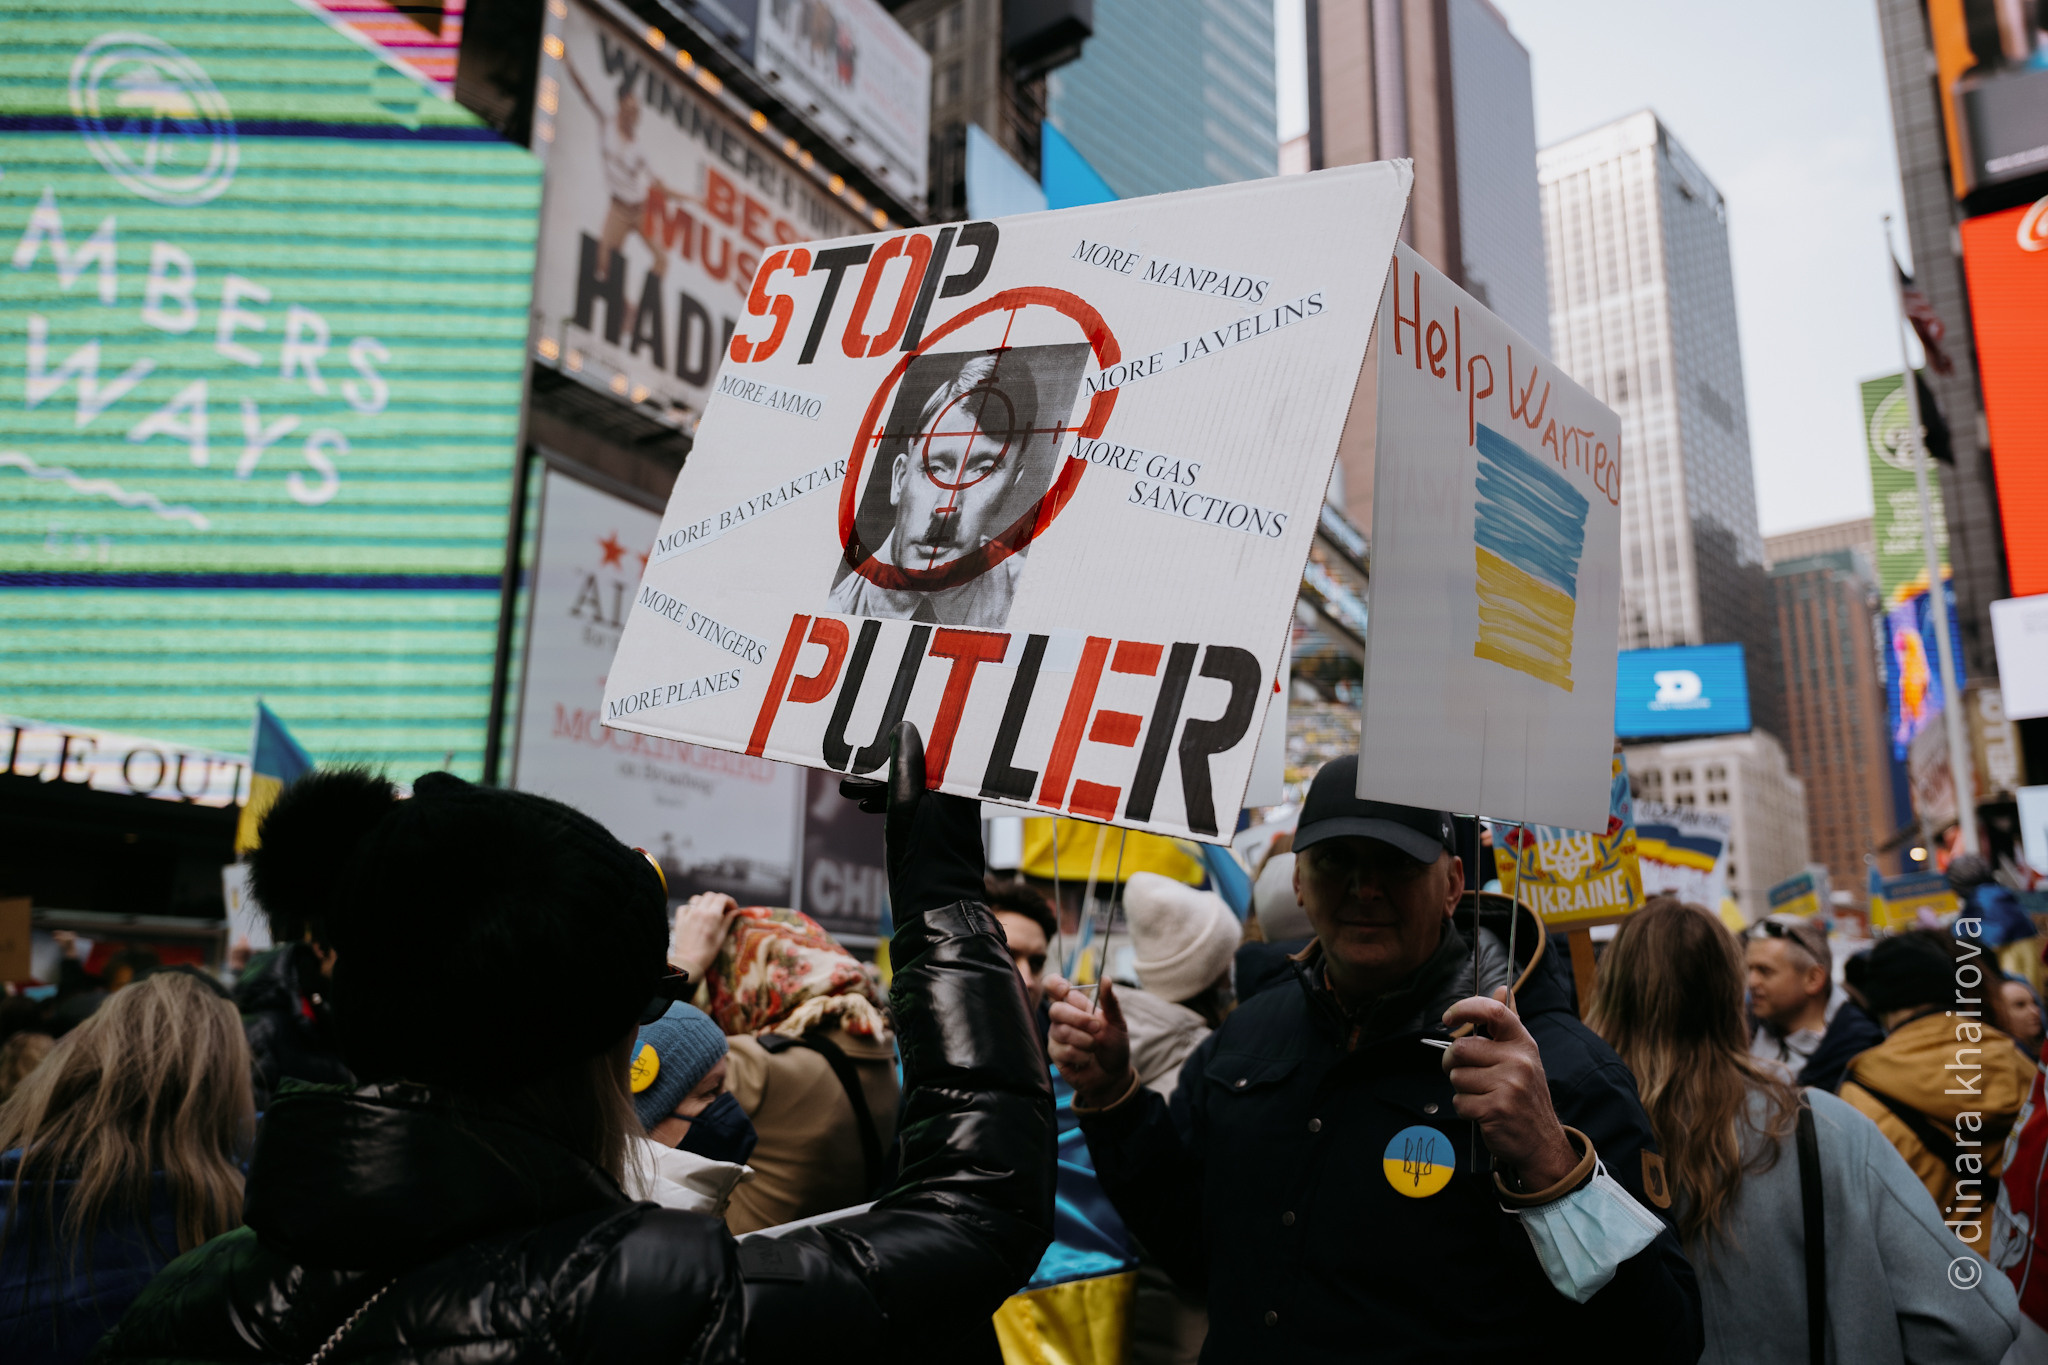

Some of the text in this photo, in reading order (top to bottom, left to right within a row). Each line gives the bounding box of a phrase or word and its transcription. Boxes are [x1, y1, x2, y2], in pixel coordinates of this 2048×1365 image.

[706, 166, 812, 250] BES
[571, 232, 737, 389] HAD
[730, 221, 999, 365] STOP
[1072, 239, 1269, 304] MORE MANPADS
[1084, 292, 1324, 398] MORE JAVELINS
[1392, 254, 1494, 447] Help
[26, 313, 350, 505] WAYS
[717, 374, 765, 403] MORE
[768, 389, 822, 420] AMMO
[1069, 436, 1201, 487] MORE GAS
[656, 458, 850, 556] MORE BAYRAKTAR
[1128, 479, 1288, 539] SANCTIONS
[639, 586, 767, 666] MORE STINGERS
[607, 667, 742, 720] MORE PLANES
[745, 613, 1262, 837] PUTLER
[1520, 867, 1628, 915] UKRAINE
